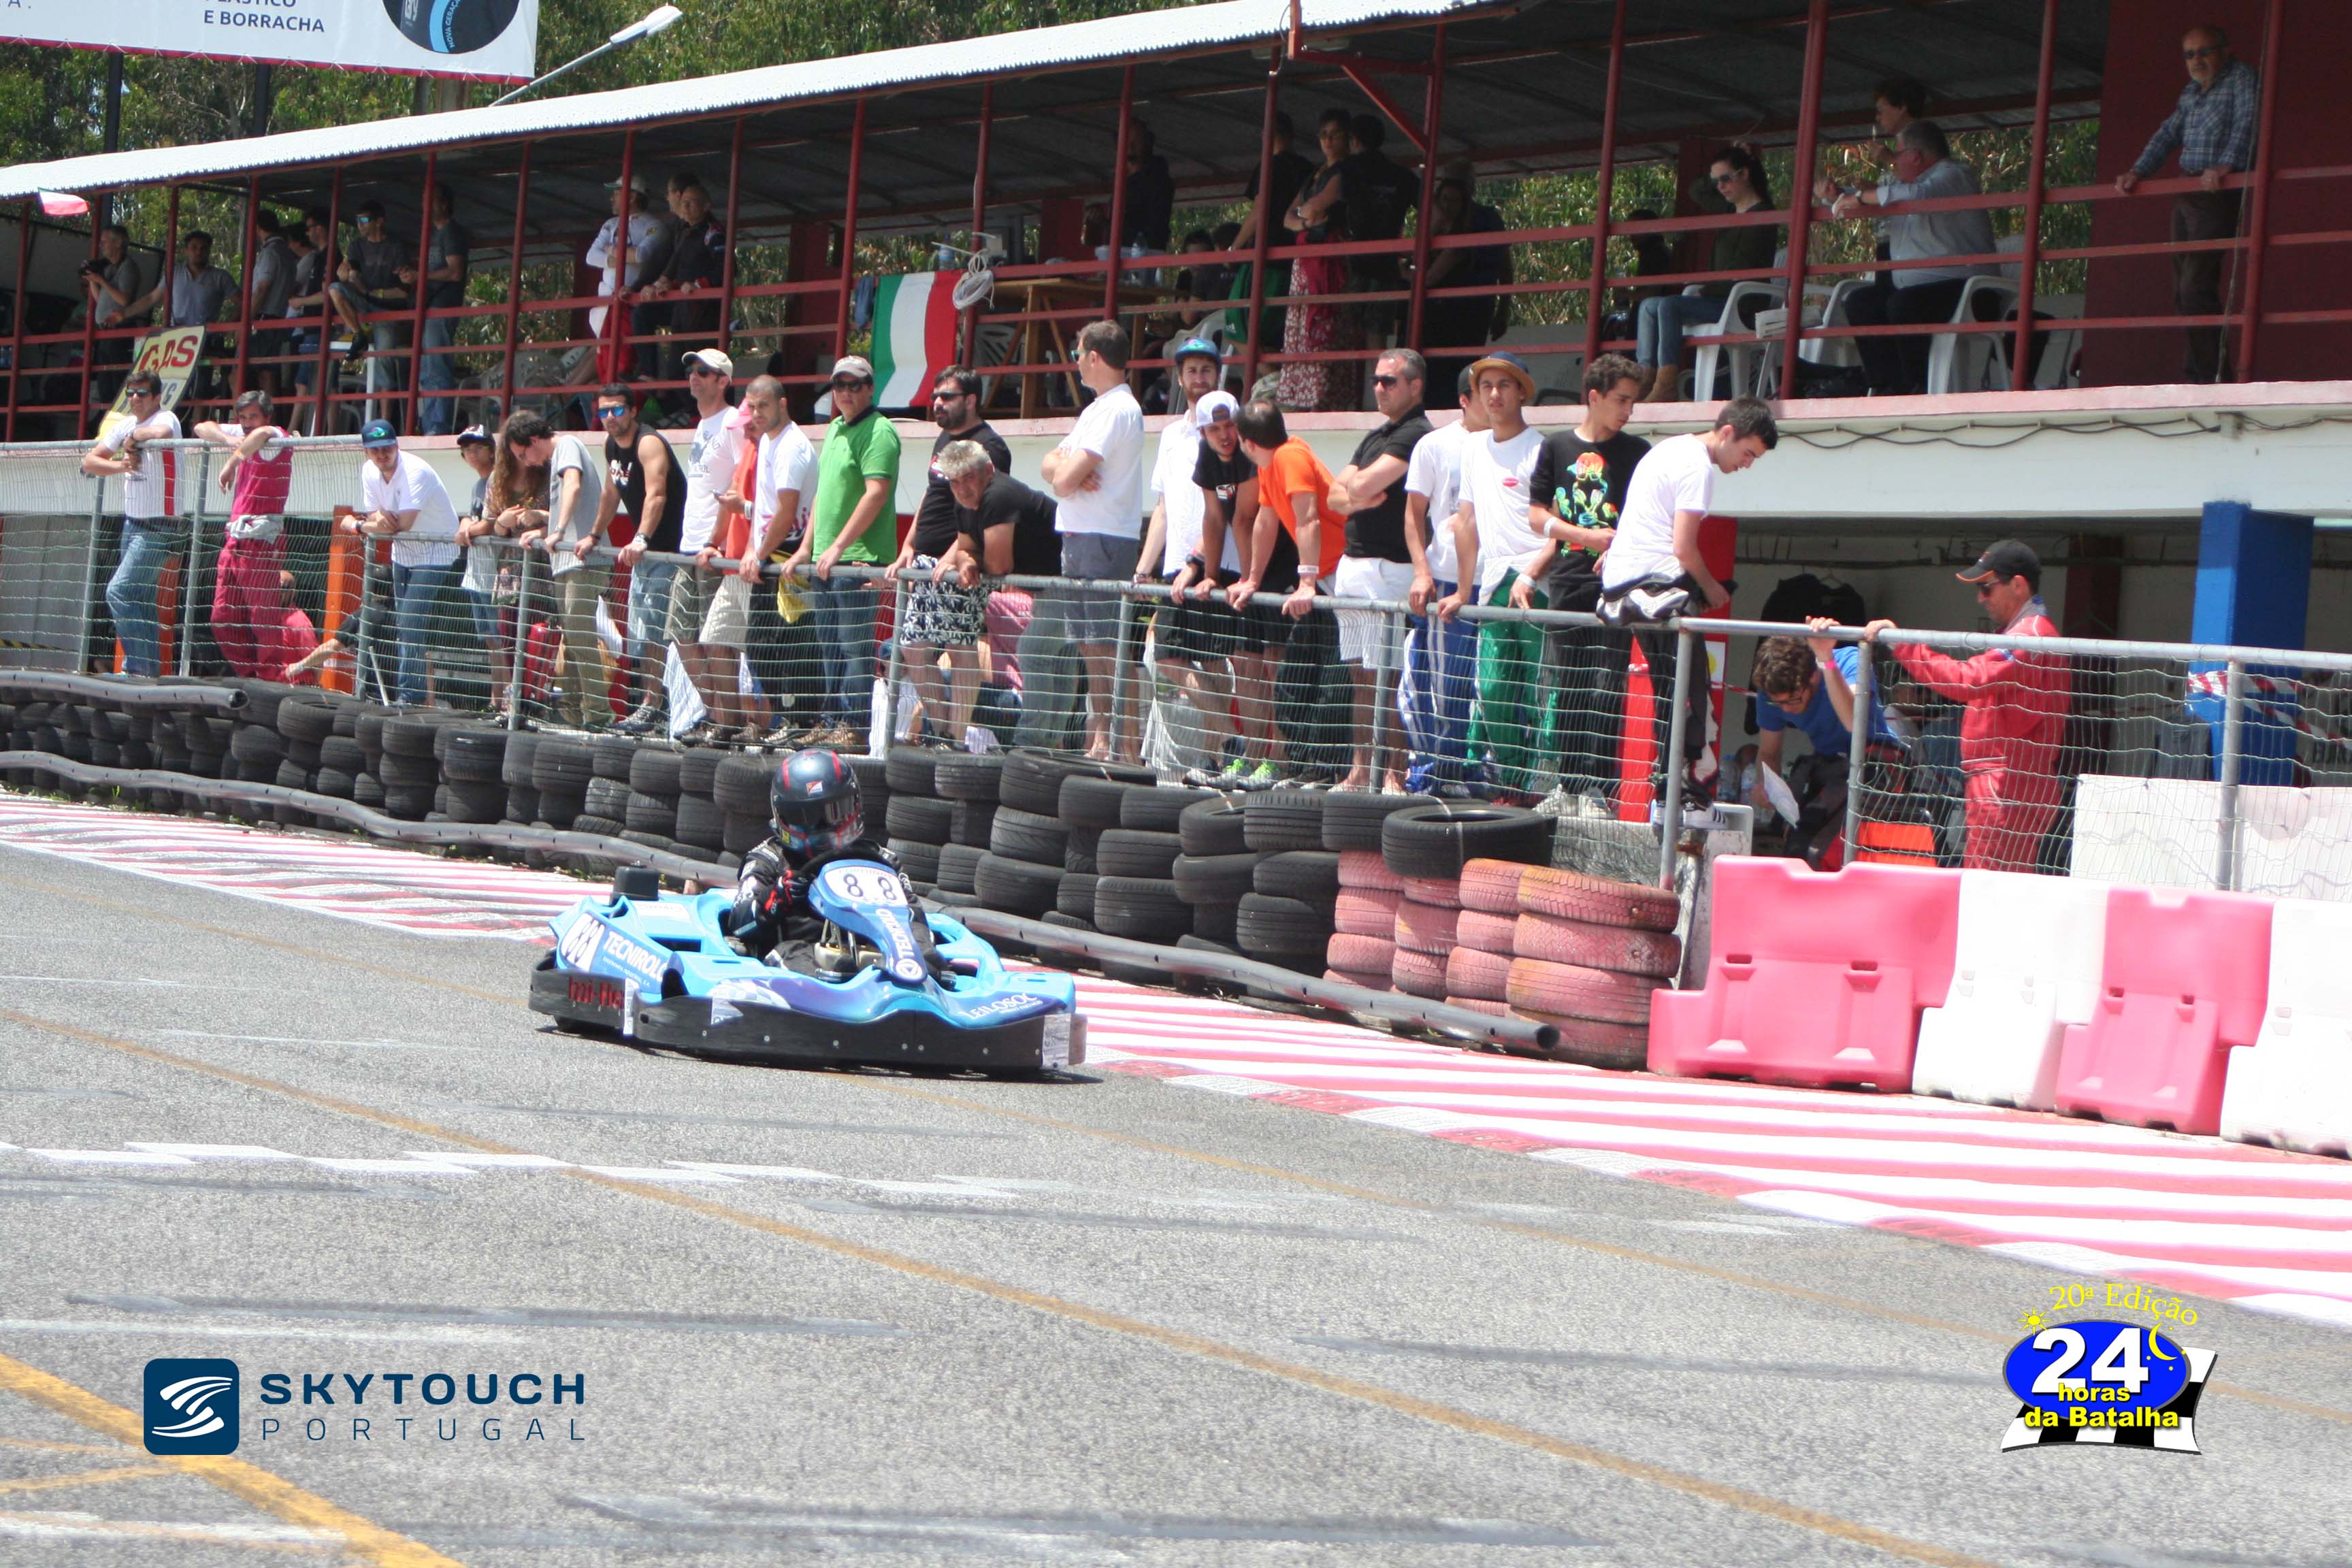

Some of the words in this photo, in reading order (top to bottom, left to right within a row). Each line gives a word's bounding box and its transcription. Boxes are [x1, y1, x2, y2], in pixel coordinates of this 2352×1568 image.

[204, 10, 214, 24] E
[219, 11, 325, 33] BORRACHA
[445, 27, 455, 48] NOVA
[138, 336, 199, 372] GAS
